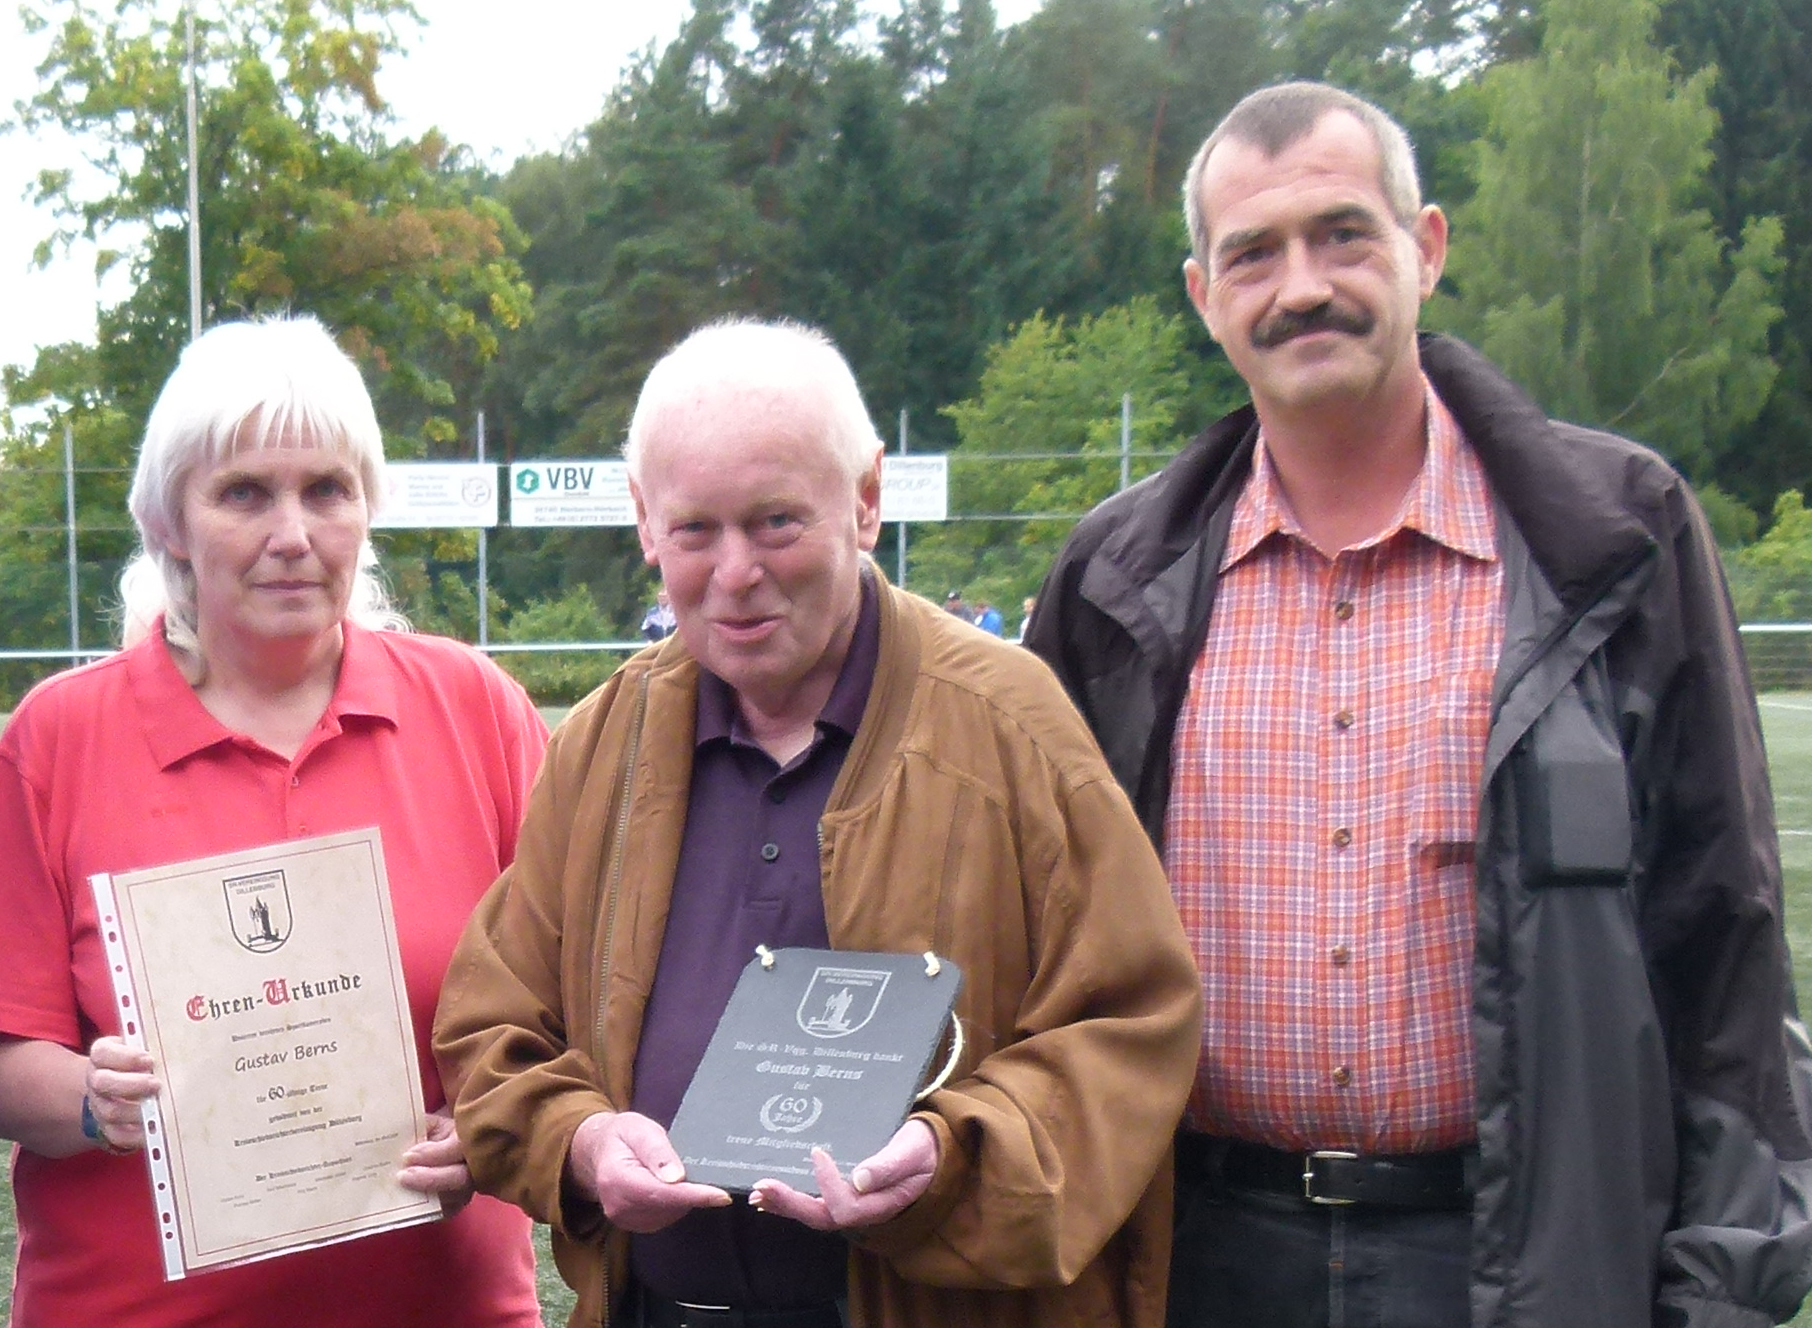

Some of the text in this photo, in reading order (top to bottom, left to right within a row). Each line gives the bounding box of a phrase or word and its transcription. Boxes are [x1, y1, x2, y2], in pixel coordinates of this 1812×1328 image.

[547, 467, 594, 490] VBV
[186, 973, 362, 1022] Ehren-Urkunde
[235, 1040, 338, 1072] Gustav Berns
[813, 1046, 872, 1062] Dillenburg
[756, 1060, 863, 1081] Gustav Berns
[779, 1097, 807, 1113] 60
